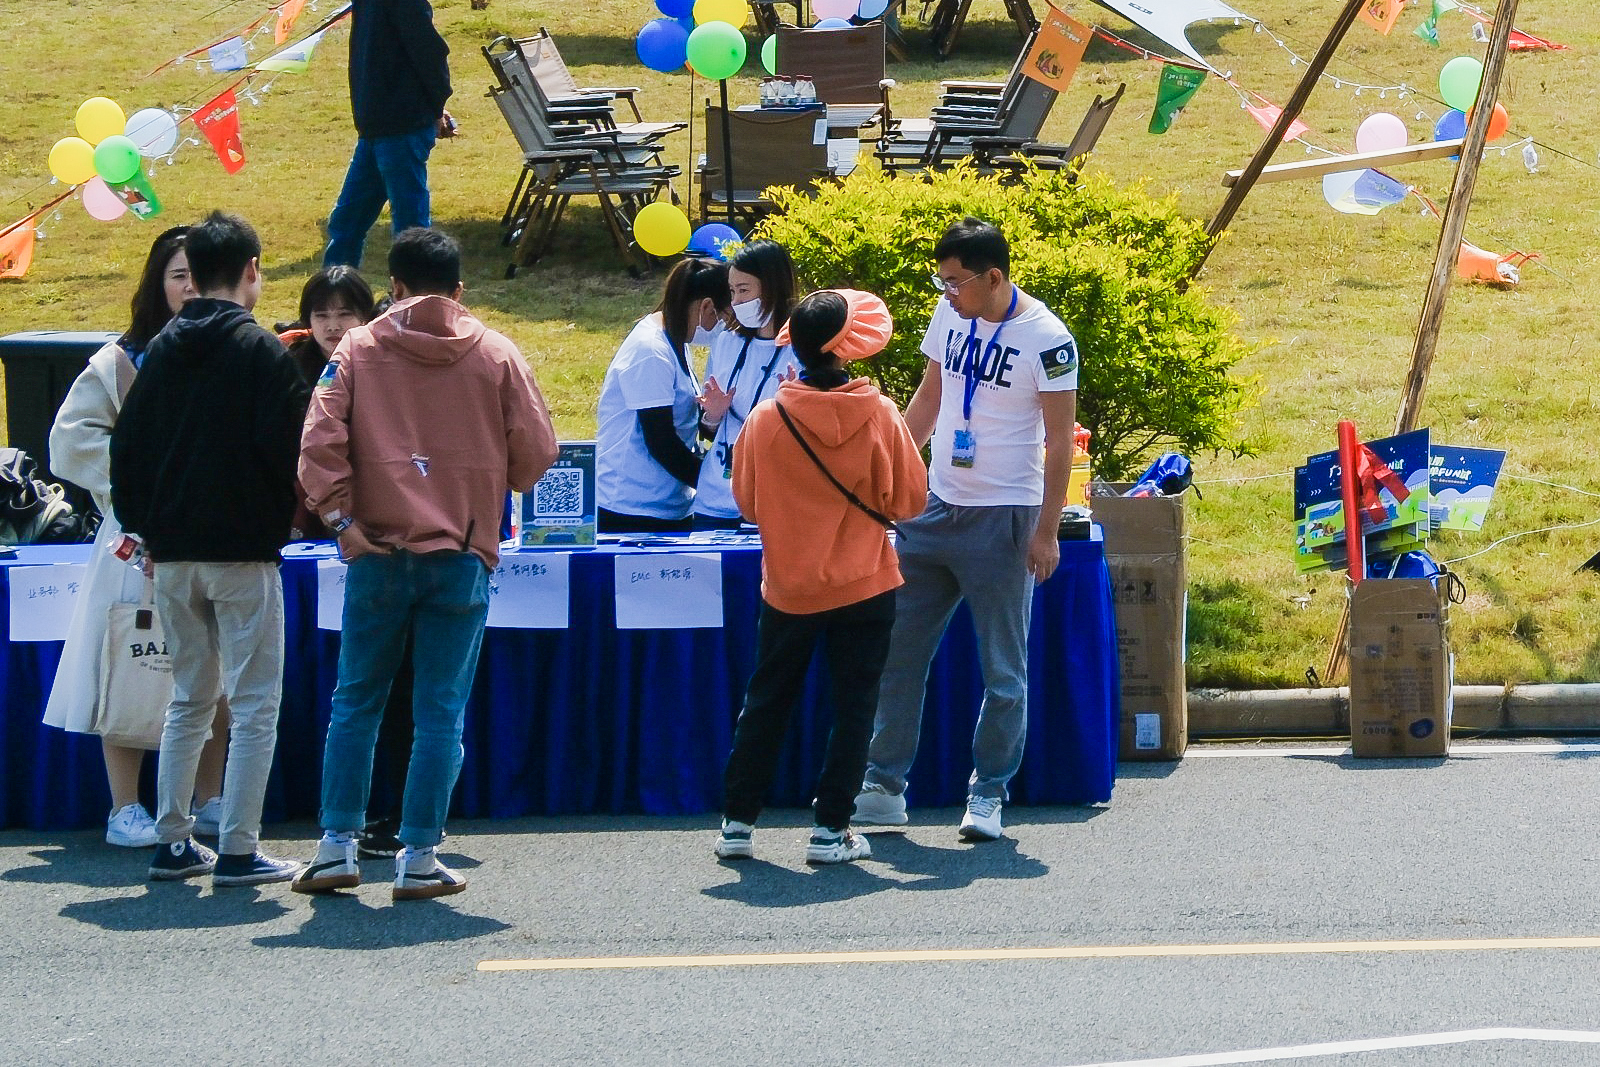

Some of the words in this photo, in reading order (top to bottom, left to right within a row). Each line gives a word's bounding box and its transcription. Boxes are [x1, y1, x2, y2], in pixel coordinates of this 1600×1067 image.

[945, 328, 1021, 389] WADE
[1059, 351, 1067, 361] 4
[630, 571, 651, 584] EMC
